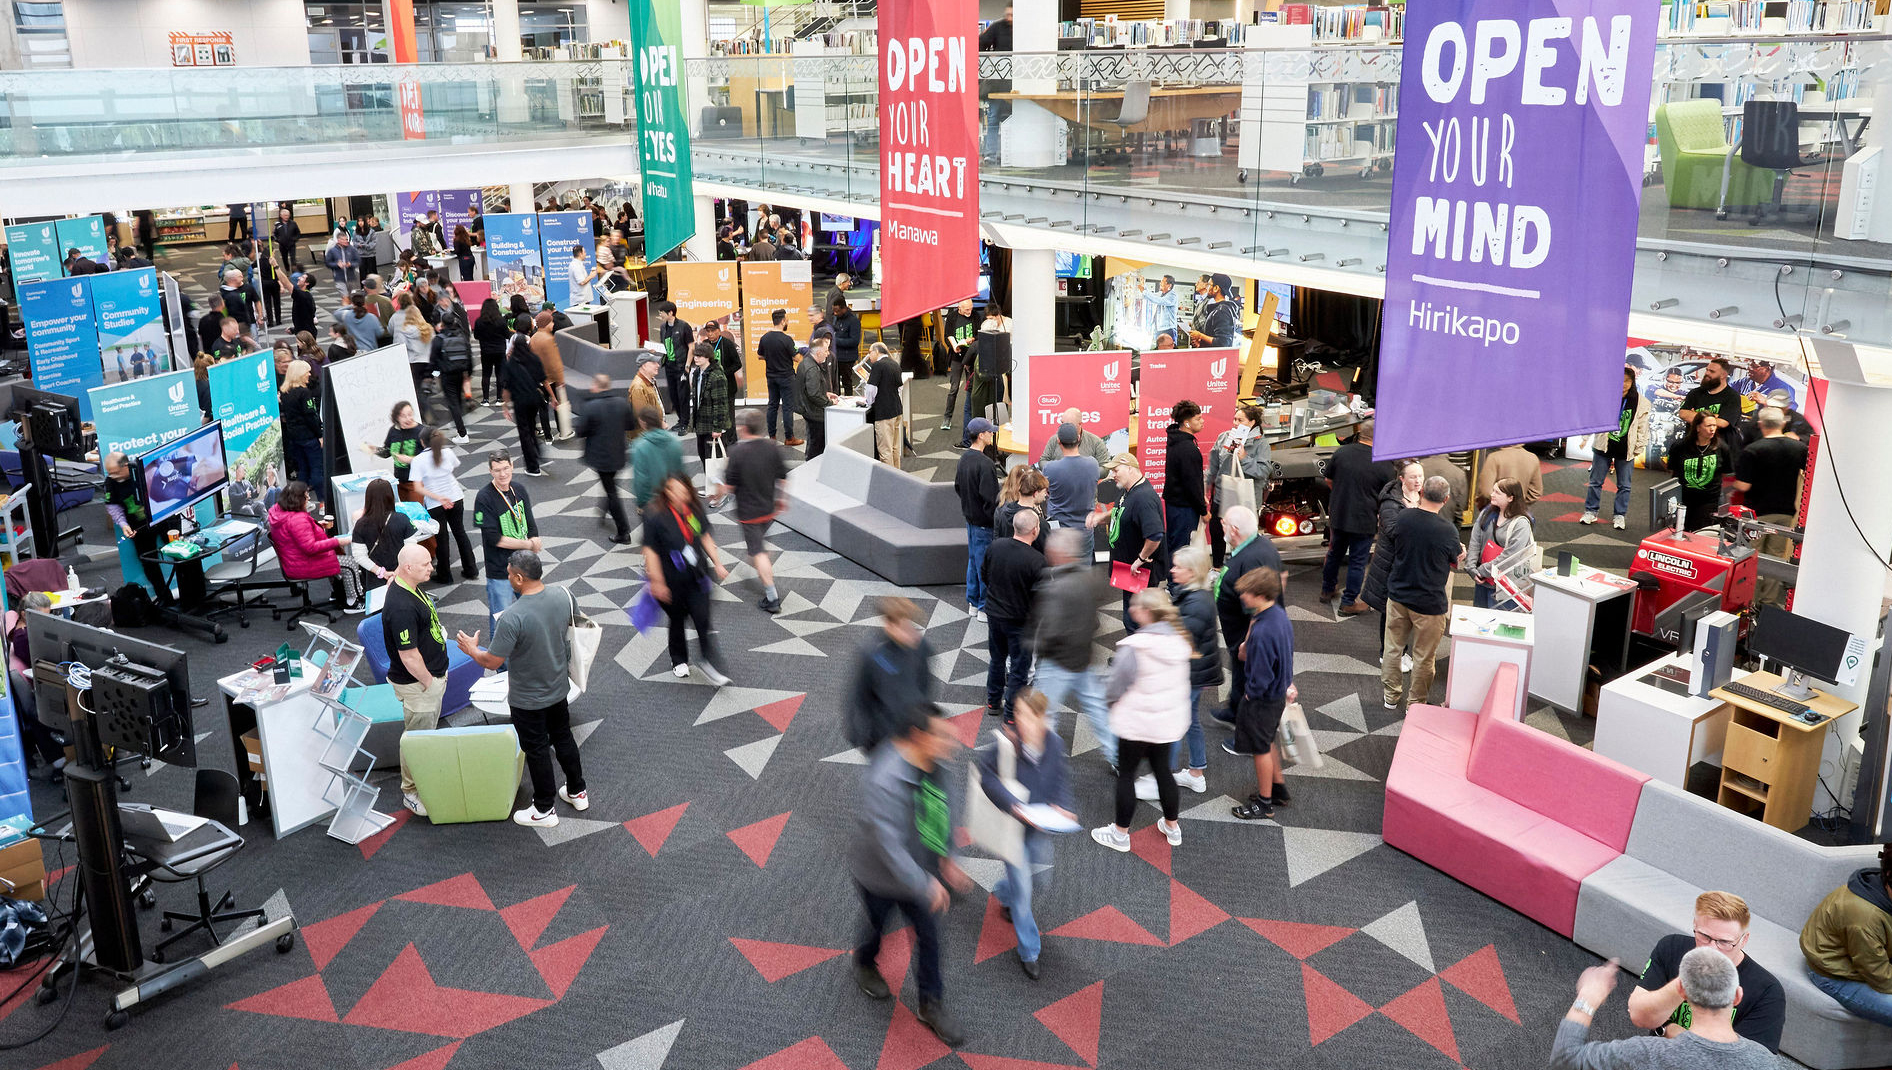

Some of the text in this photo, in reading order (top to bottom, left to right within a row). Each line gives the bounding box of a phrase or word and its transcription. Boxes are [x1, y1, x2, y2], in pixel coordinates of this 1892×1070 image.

[194, 36, 228, 44] RESPONSE
[886, 36, 967, 95] OPEN
[1421, 13, 1632, 107] OPEN
[888, 103, 930, 150] YOUR
[1422, 113, 1515, 189] YOUR
[888, 151, 968, 200] HEART
[887, 219, 940, 247] Manawa
[1411, 196, 1552, 269] MIND
[491, 242, 518, 250] Building
[491, 248, 535, 256] Construction
[13, 249, 41, 259] Innovate
[14, 255, 50, 266] tomorrow's
[16, 264, 34, 273] world
[675, 299, 733, 309] Engineering
[750, 297, 789, 306] Engineer
[102, 306, 150, 321] Community
[750, 307, 770, 317] your
[30, 313, 88, 329] Empower your
[104, 318, 136, 330] Studies
[1408, 299, 1521, 347] Hirikapo
[31, 323, 77, 338] community
[33, 336, 81, 350] Community Sport
[40, 345, 70, 355] Recreation
[36, 353, 78, 368] Early Childhood
[37, 362, 65, 372] Education
[38, 372, 62, 381] Exercise
[40, 377, 81, 391] Sport Coaching
[1206, 380, 1228, 388] Unitec
[101, 395, 131, 407] Healthcare
[102, 400, 142, 413] Social Practice
[168, 402, 190, 412] Unitec
[1041, 396, 1058, 405] Study
[221, 404, 267, 431] Healthcare &
[222, 415, 275, 444] Social Practice
[108, 434, 159, 455] Protect
[160, 425, 189, 447] your
[1650, 552, 1690, 570] LINCOLN
[1657, 563, 1692, 577] ELECTRIC
